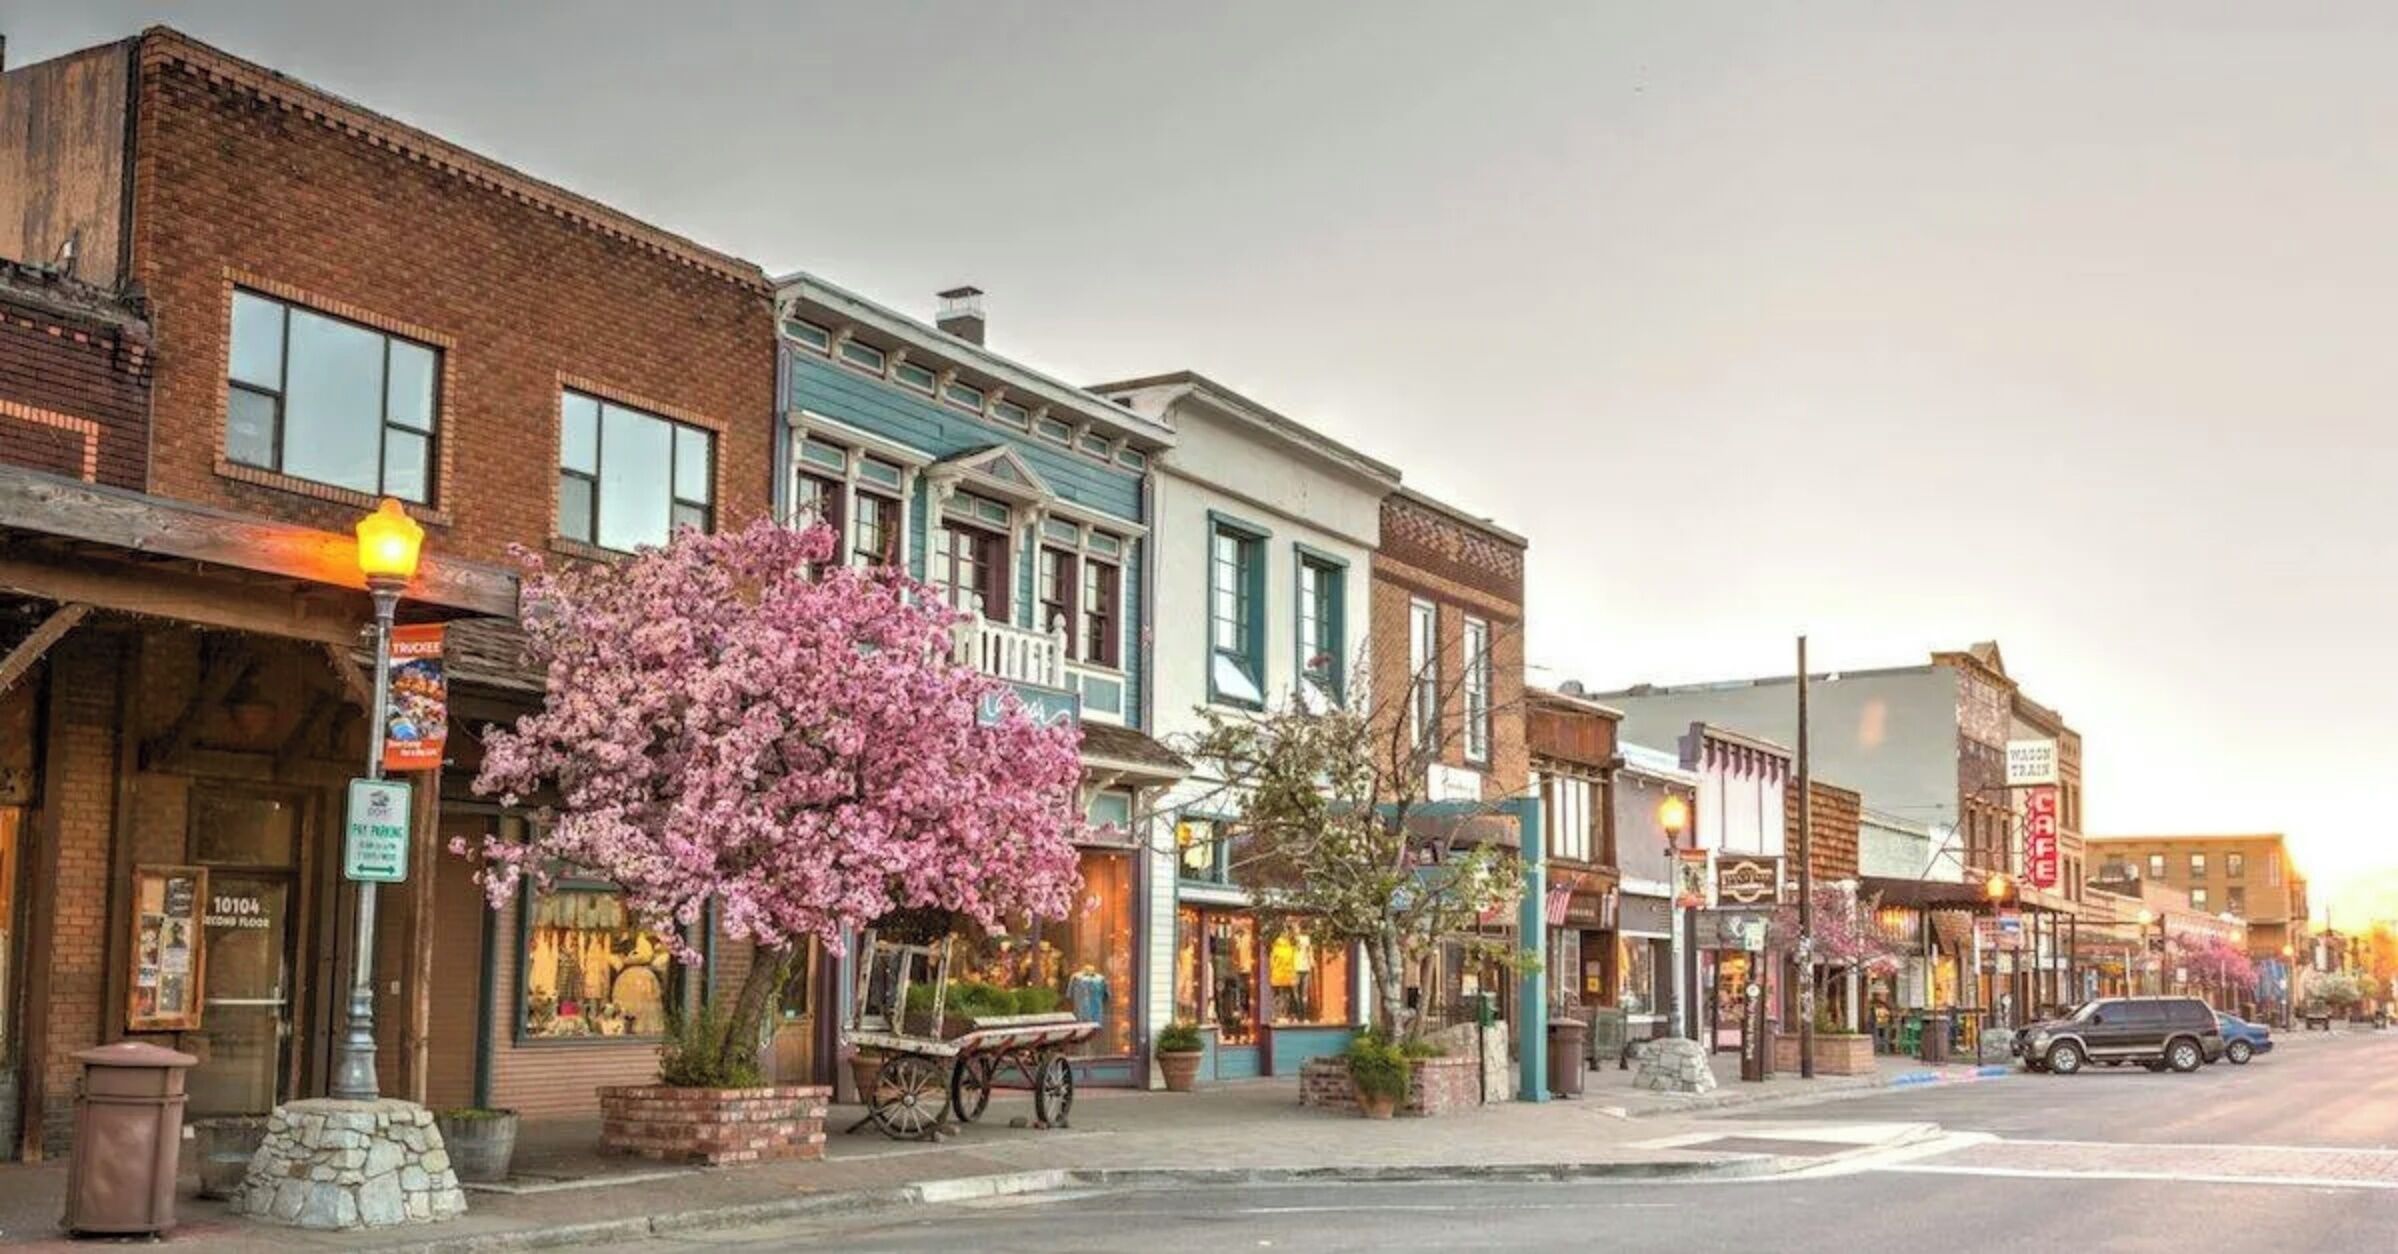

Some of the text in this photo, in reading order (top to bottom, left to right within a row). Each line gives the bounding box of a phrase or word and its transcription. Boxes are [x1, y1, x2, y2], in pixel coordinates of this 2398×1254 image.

[392, 641, 442, 654] TRUCKEE
[2010, 747, 2051, 761] WAGON
[2011, 763, 2050, 777] TRAIN
[2033, 791, 2056, 881] CAFE
[213, 895, 260, 915] 10104
[239, 916, 271, 929] FLOOR
